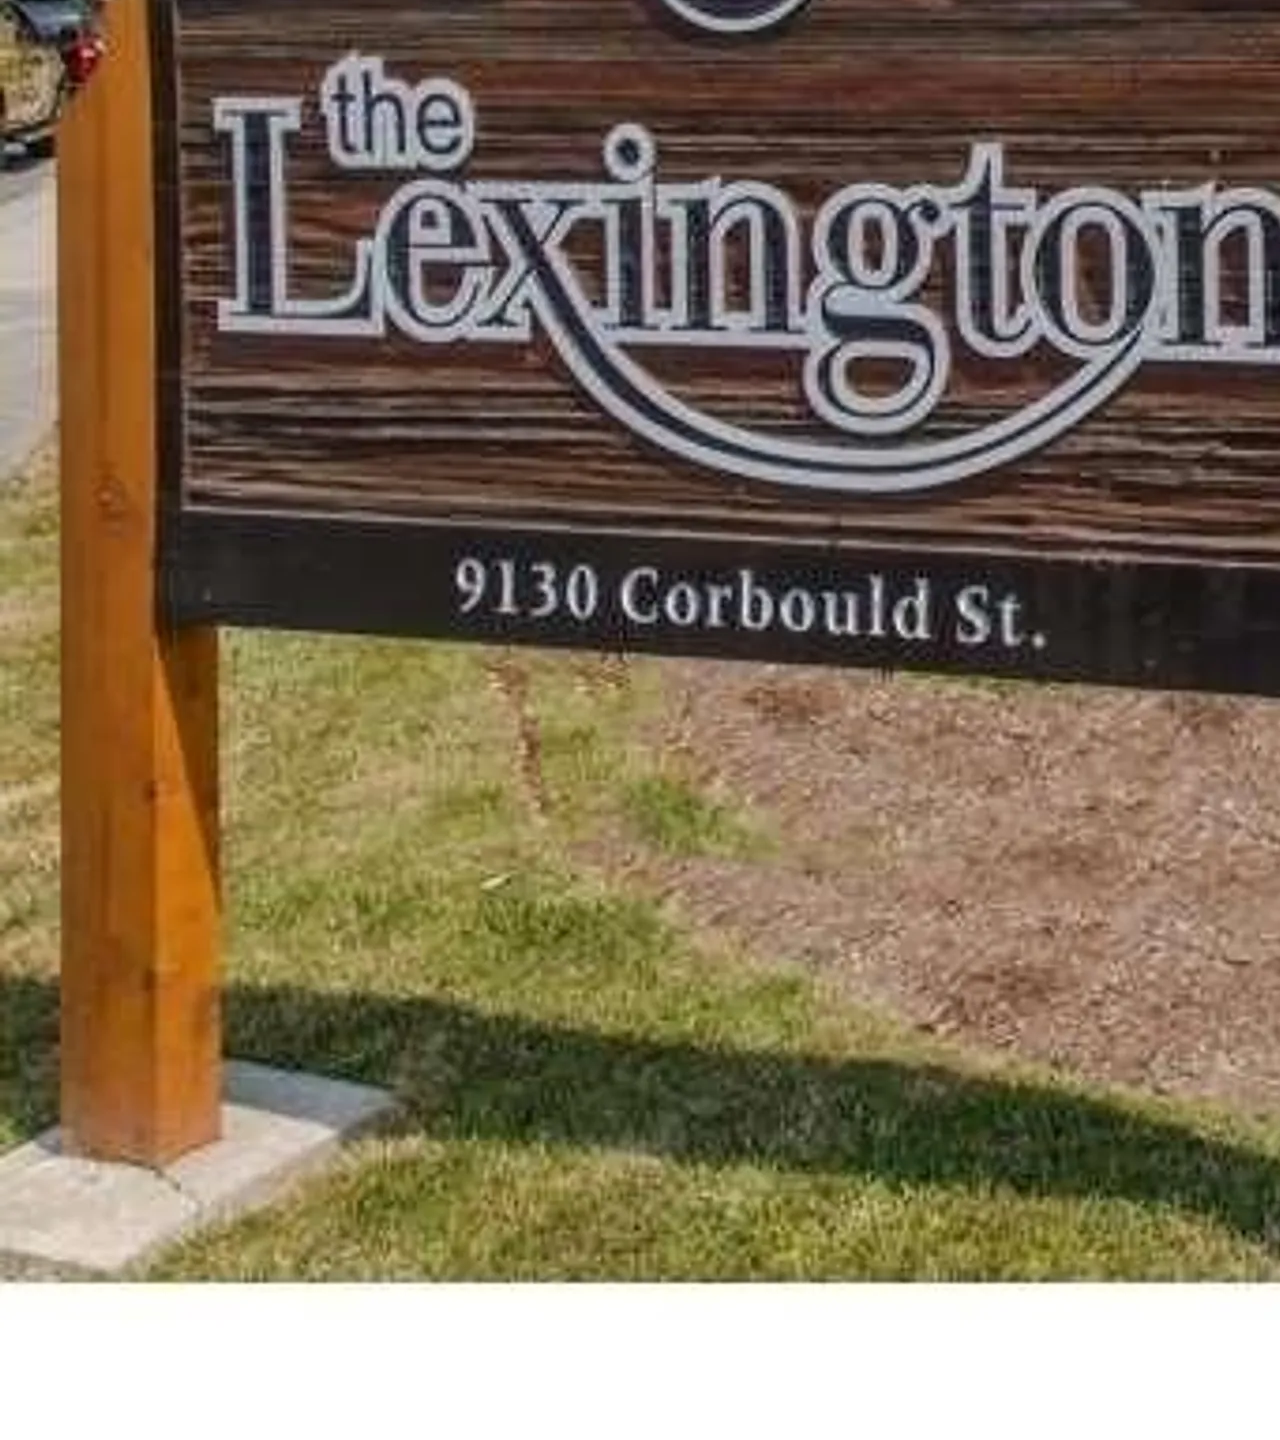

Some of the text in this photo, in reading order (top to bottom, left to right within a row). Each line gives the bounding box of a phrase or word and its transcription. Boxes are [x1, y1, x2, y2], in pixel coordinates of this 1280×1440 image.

[321, 53, 474, 170] the
[455, 559, 1048, 649] 9130 Corbould St.
